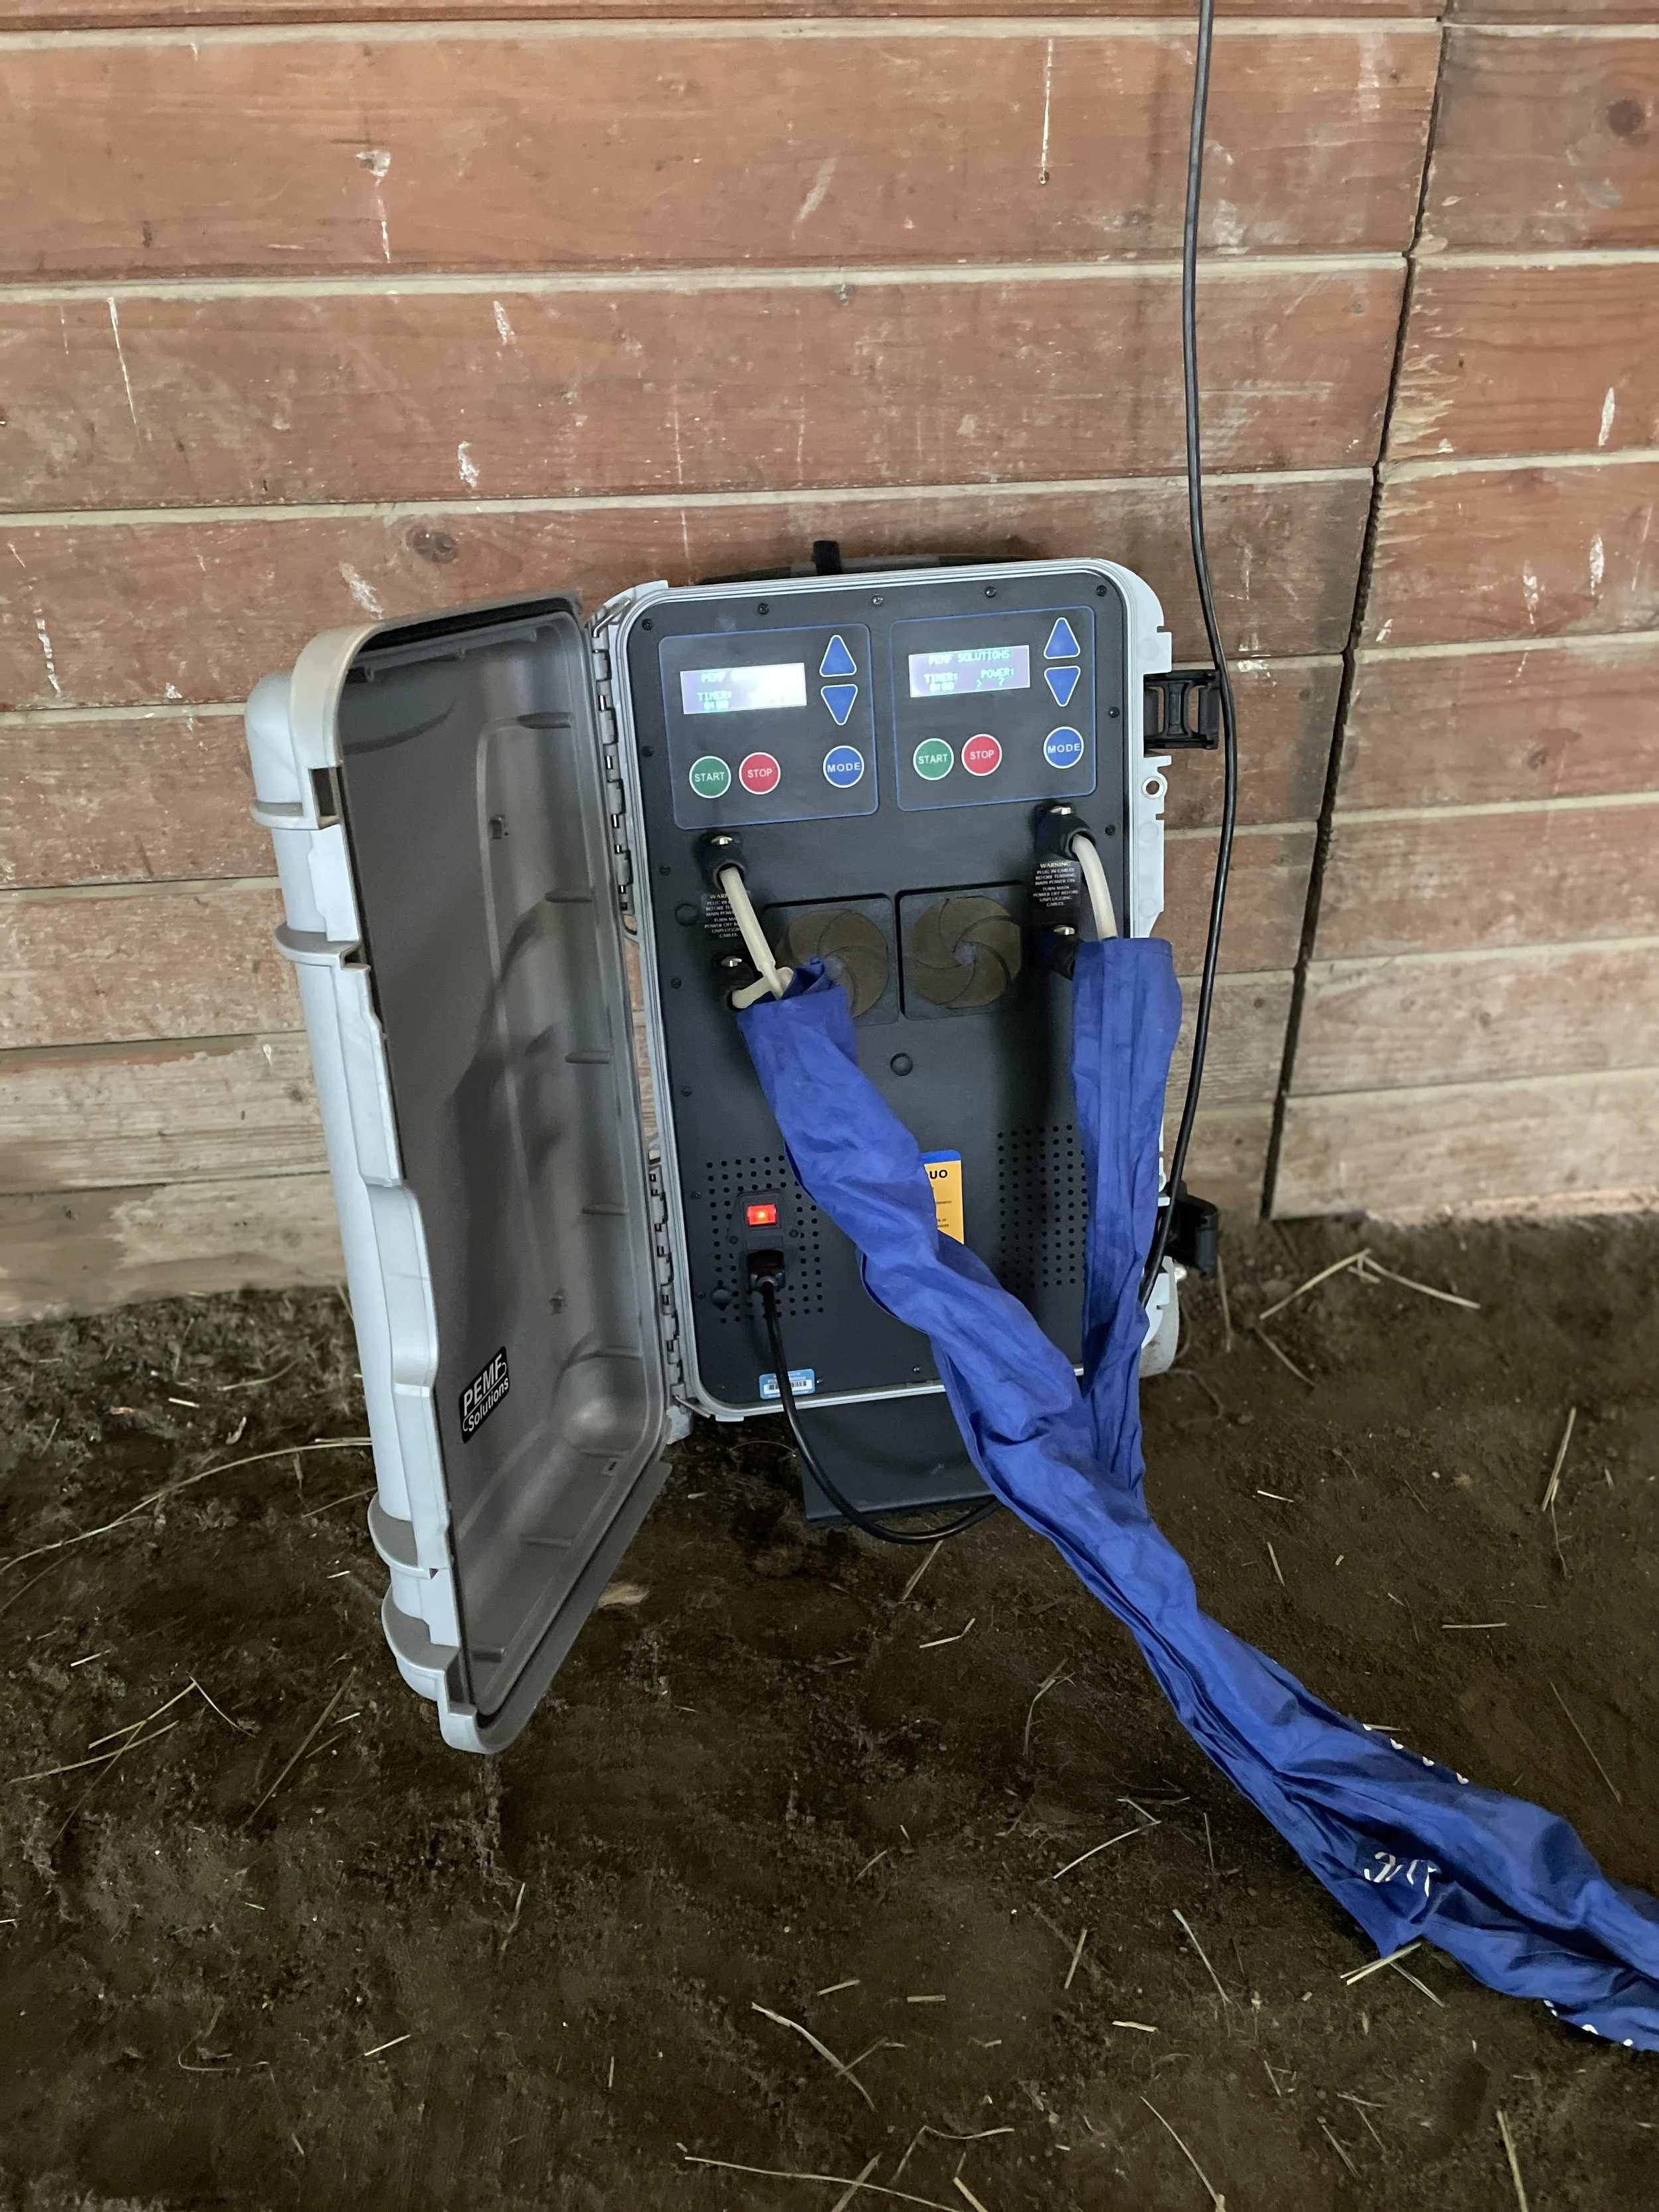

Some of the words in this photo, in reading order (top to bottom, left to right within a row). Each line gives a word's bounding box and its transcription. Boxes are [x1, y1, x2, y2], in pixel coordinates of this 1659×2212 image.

[957, 649, 1010, 663] SOLUTIONS
[980, 667, 1015, 679] POWER:
[1047, 742, 1081, 754] MODE
[918, 753, 948, 764] START
[969, 749, 994, 760] STOP
[747, 767, 773, 778] STOP
[827, 761, 861, 773] MODE
[694, 771, 725, 782] START
[929, 1169, 948, 1179] UO
[464, 1353, 502, 1417] PEMF
[469, 1377, 509, 1432] Solutions
